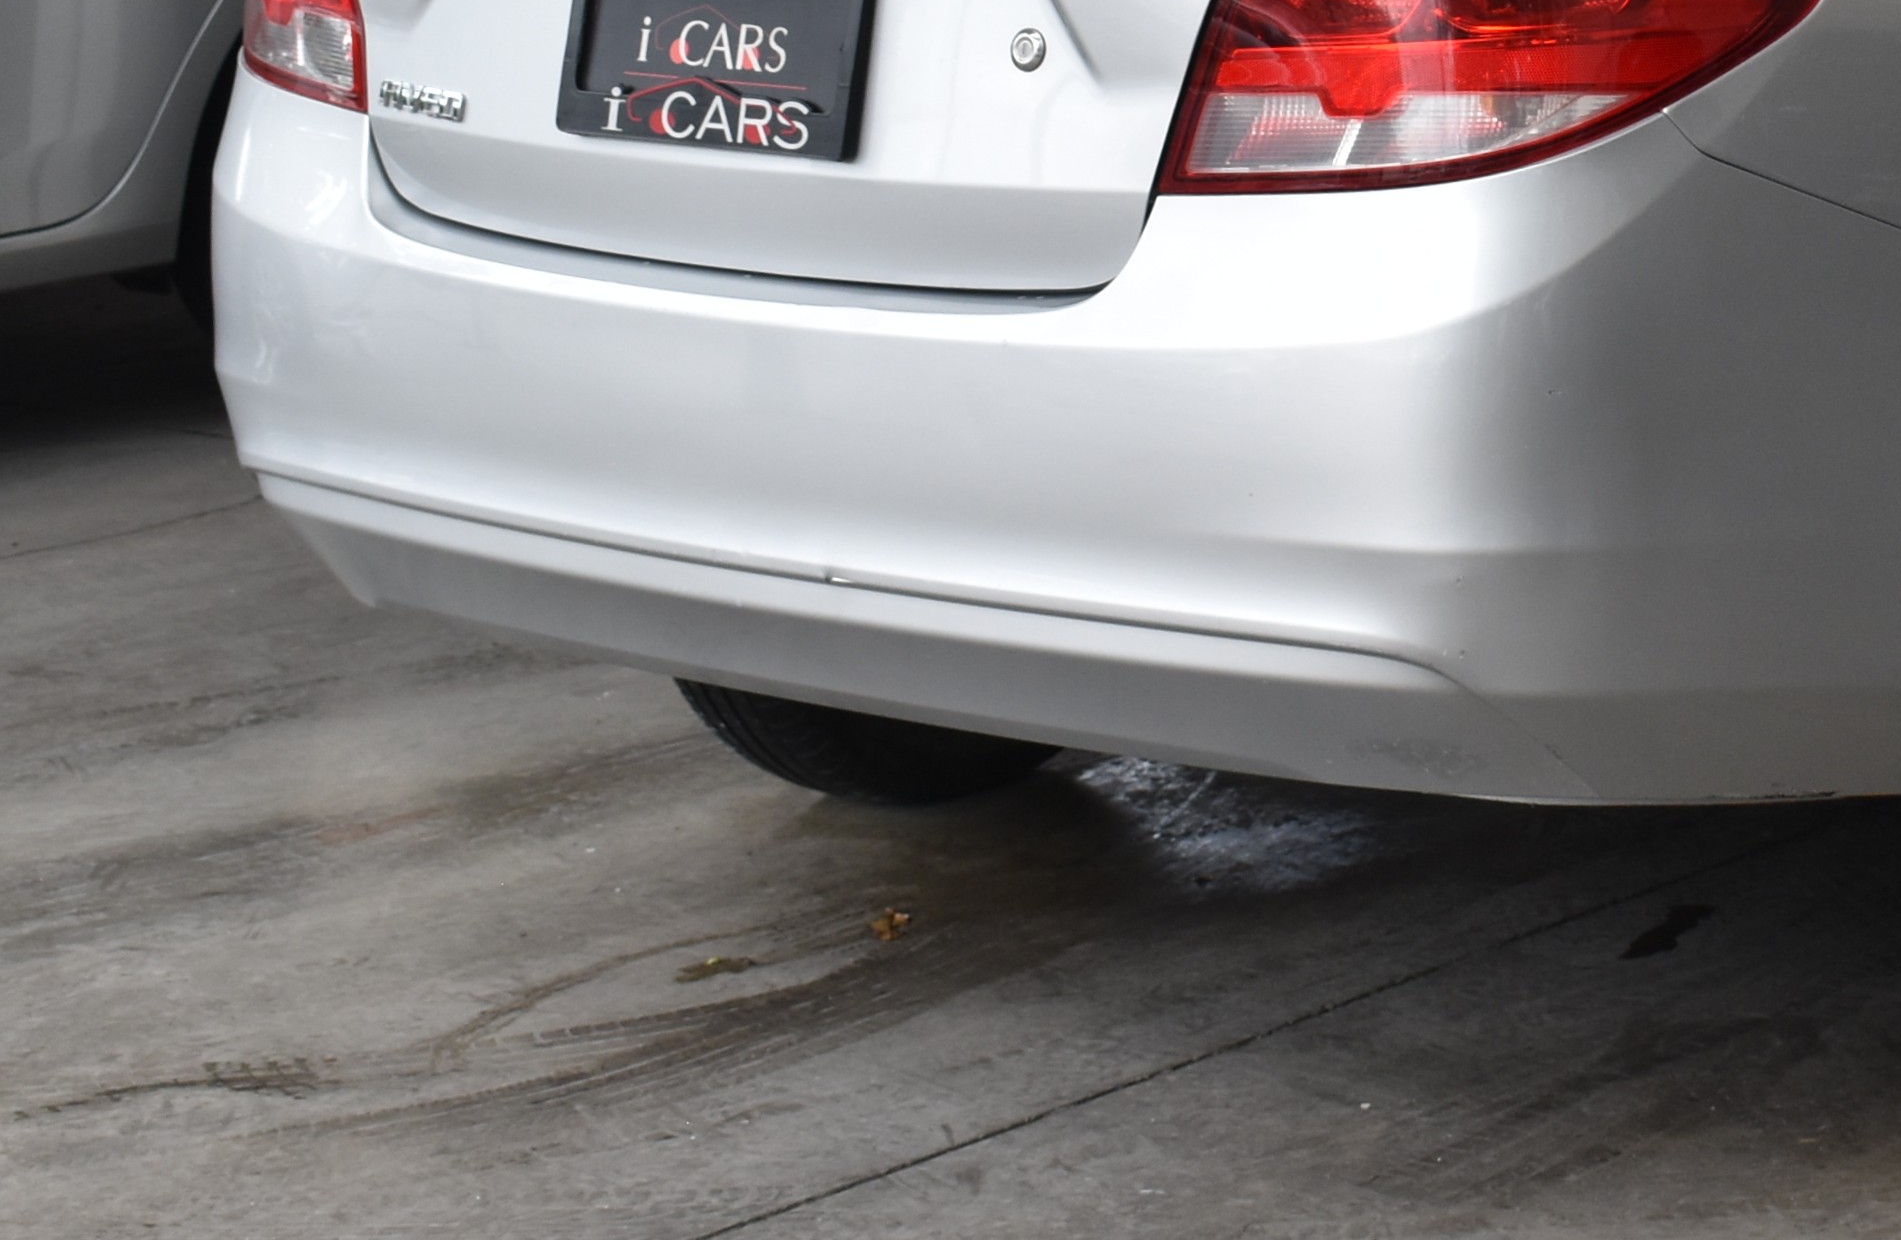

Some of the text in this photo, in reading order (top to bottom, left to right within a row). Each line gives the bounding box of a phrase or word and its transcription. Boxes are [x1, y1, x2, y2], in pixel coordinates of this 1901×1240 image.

[636, 16, 789, 74] i CARS
[601, 86, 810, 151] i CARS
